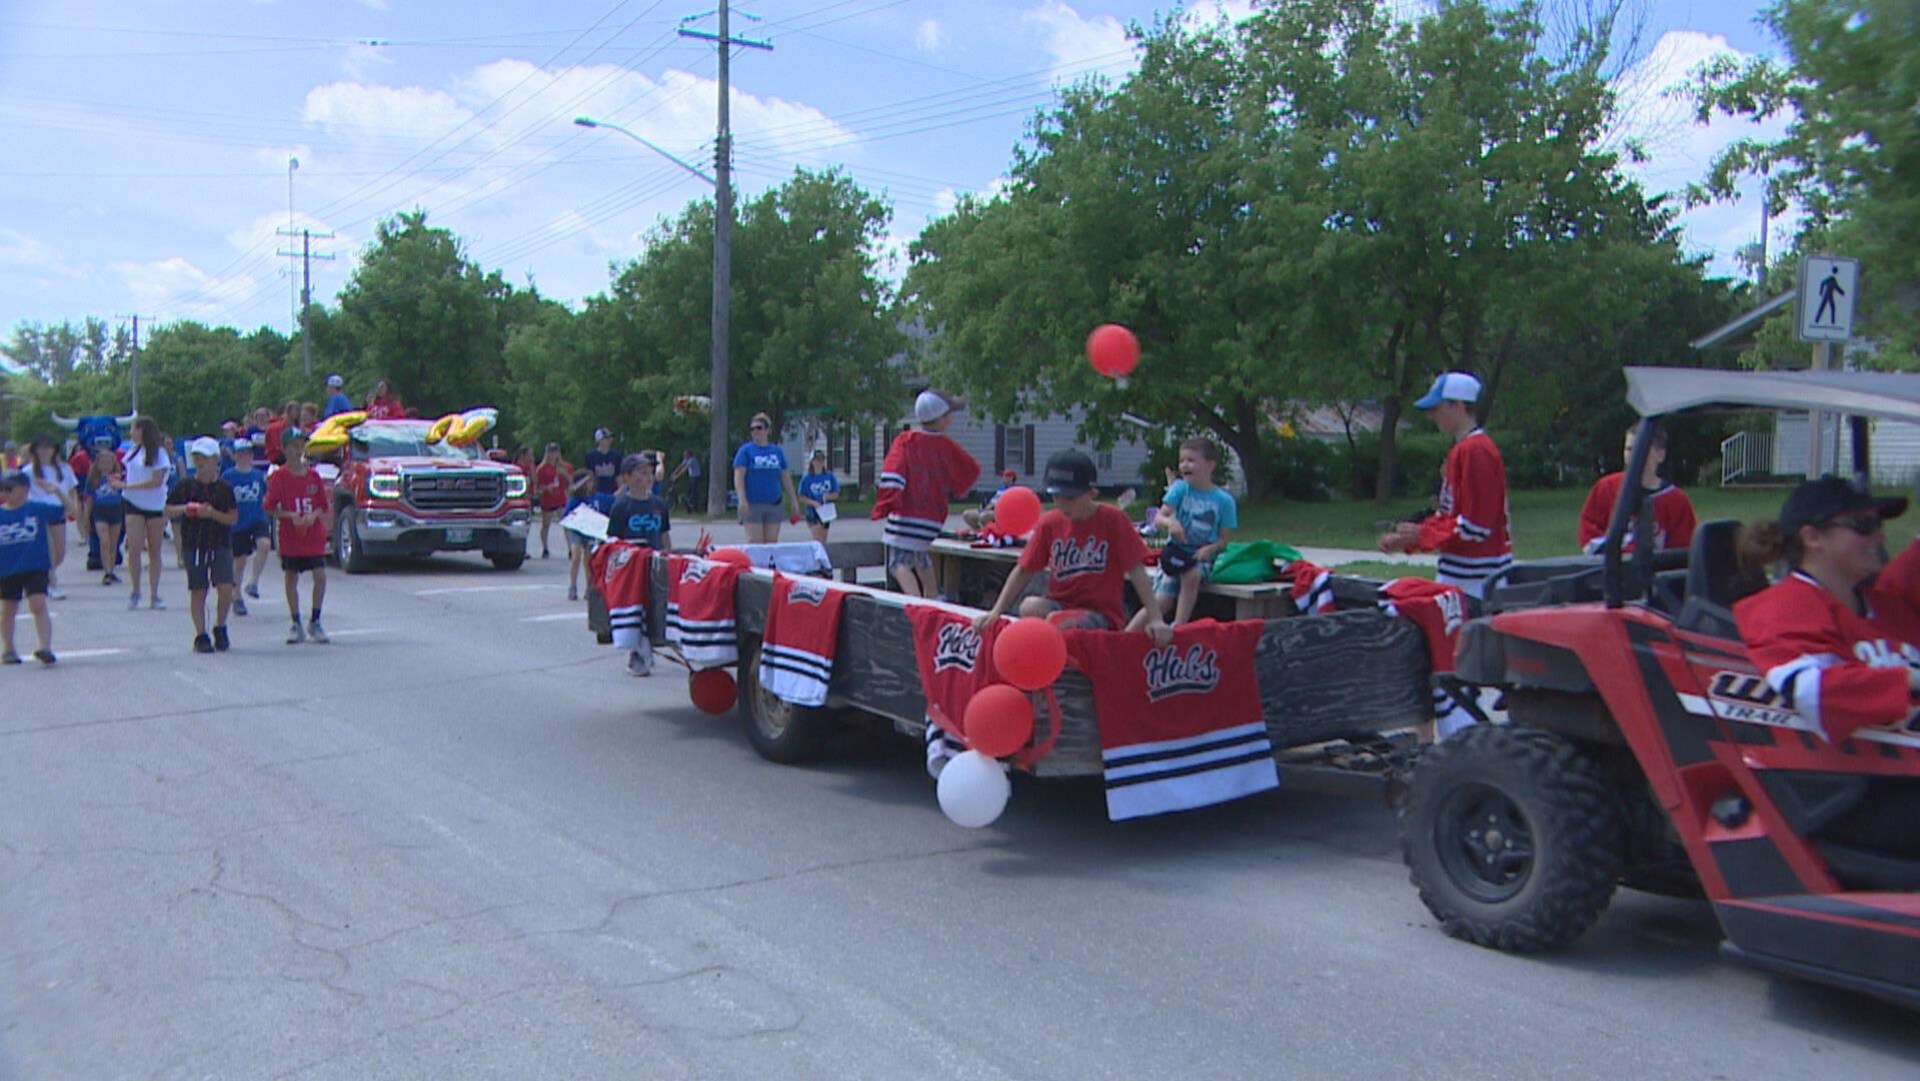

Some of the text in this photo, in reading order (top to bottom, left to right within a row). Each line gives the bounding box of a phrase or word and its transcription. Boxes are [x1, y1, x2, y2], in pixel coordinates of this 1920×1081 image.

[437, 479, 476, 490] GMC
[295, 497, 313, 513] 15
[1051, 535, 1108, 570] Habs
[938, 623, 982, 661] Habs
[1143, 643, 1219, 688] Habs
[1723, 703, 1793, 725] TRAIL
